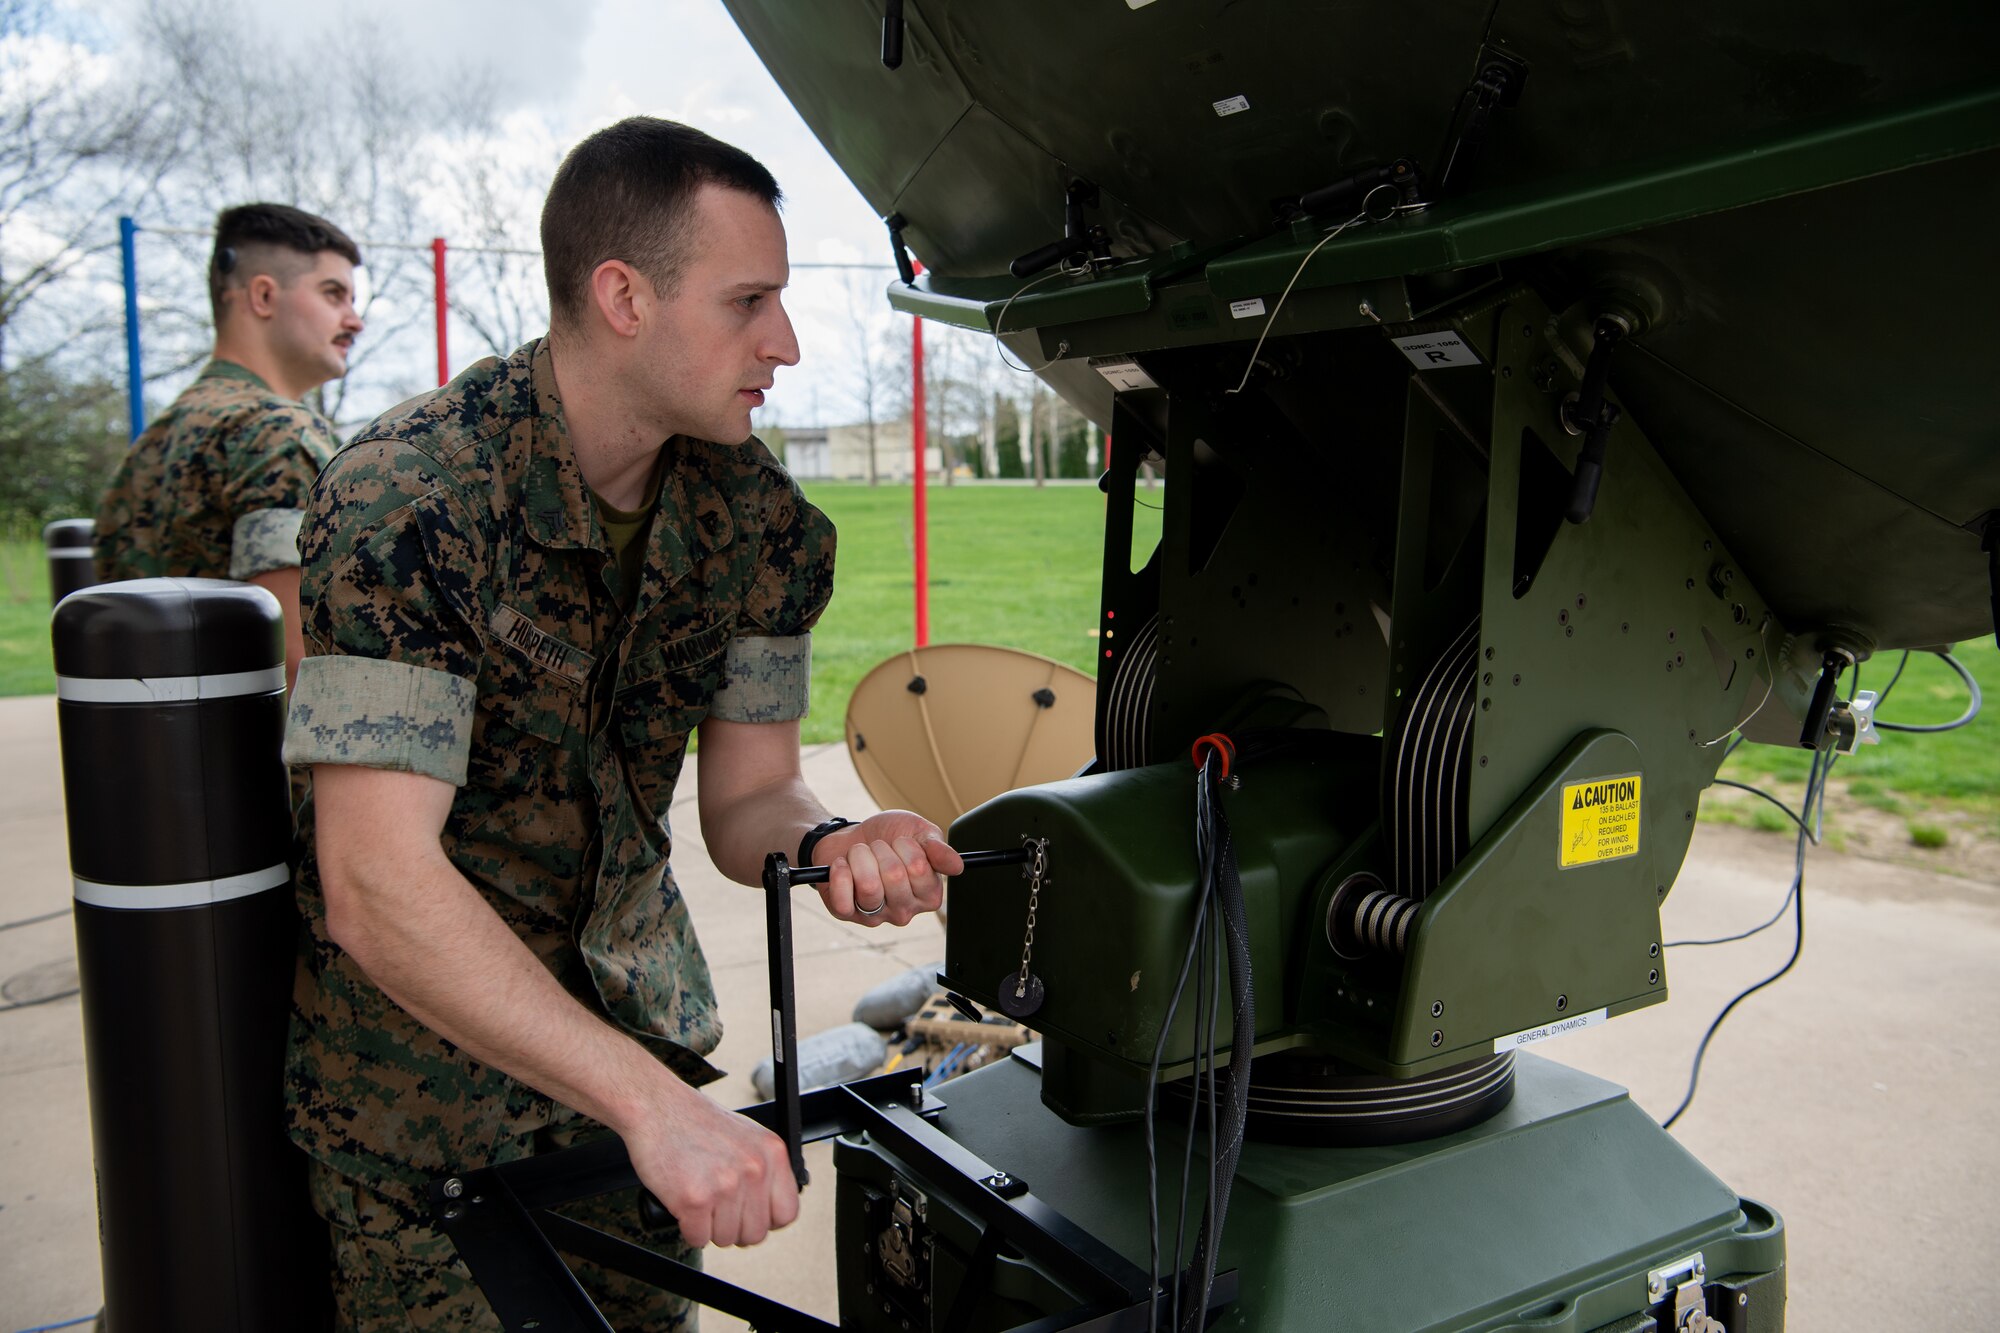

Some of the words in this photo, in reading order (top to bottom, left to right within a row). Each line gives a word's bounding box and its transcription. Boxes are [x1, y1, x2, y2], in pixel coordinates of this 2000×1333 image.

[1424, 351, 1452, 363] R
[1121, 379, 1139, 388] L
[659, 621, 731, 670] MARINES
[1585, 781, 1635, 807] CAUTION
[1599, 805, 1609, 814] 135
[1610, 804, 1615, 812] lb
[1615, 800, 1639, 811] BALLAST
[1598, 816, 1607, 825] ON
[1608, 814, 1624, 823] EACH
[1624, 812, 1636, 821] LEG
[1598, 824, 1627, 836] REQUIRED
[1597, 838, 1610, 847] FOR
[1611, 834, 1629, 845] WINDS
[1597, 848, 1614, 858] OVER
[1614, 846, 1621, 855] 15
[1621, 844, 1634, 854] MPH
[1516, 1029, 1549, 1044] GENERAL
[1552, 1017, 1586, 1034] DYNAMICS
